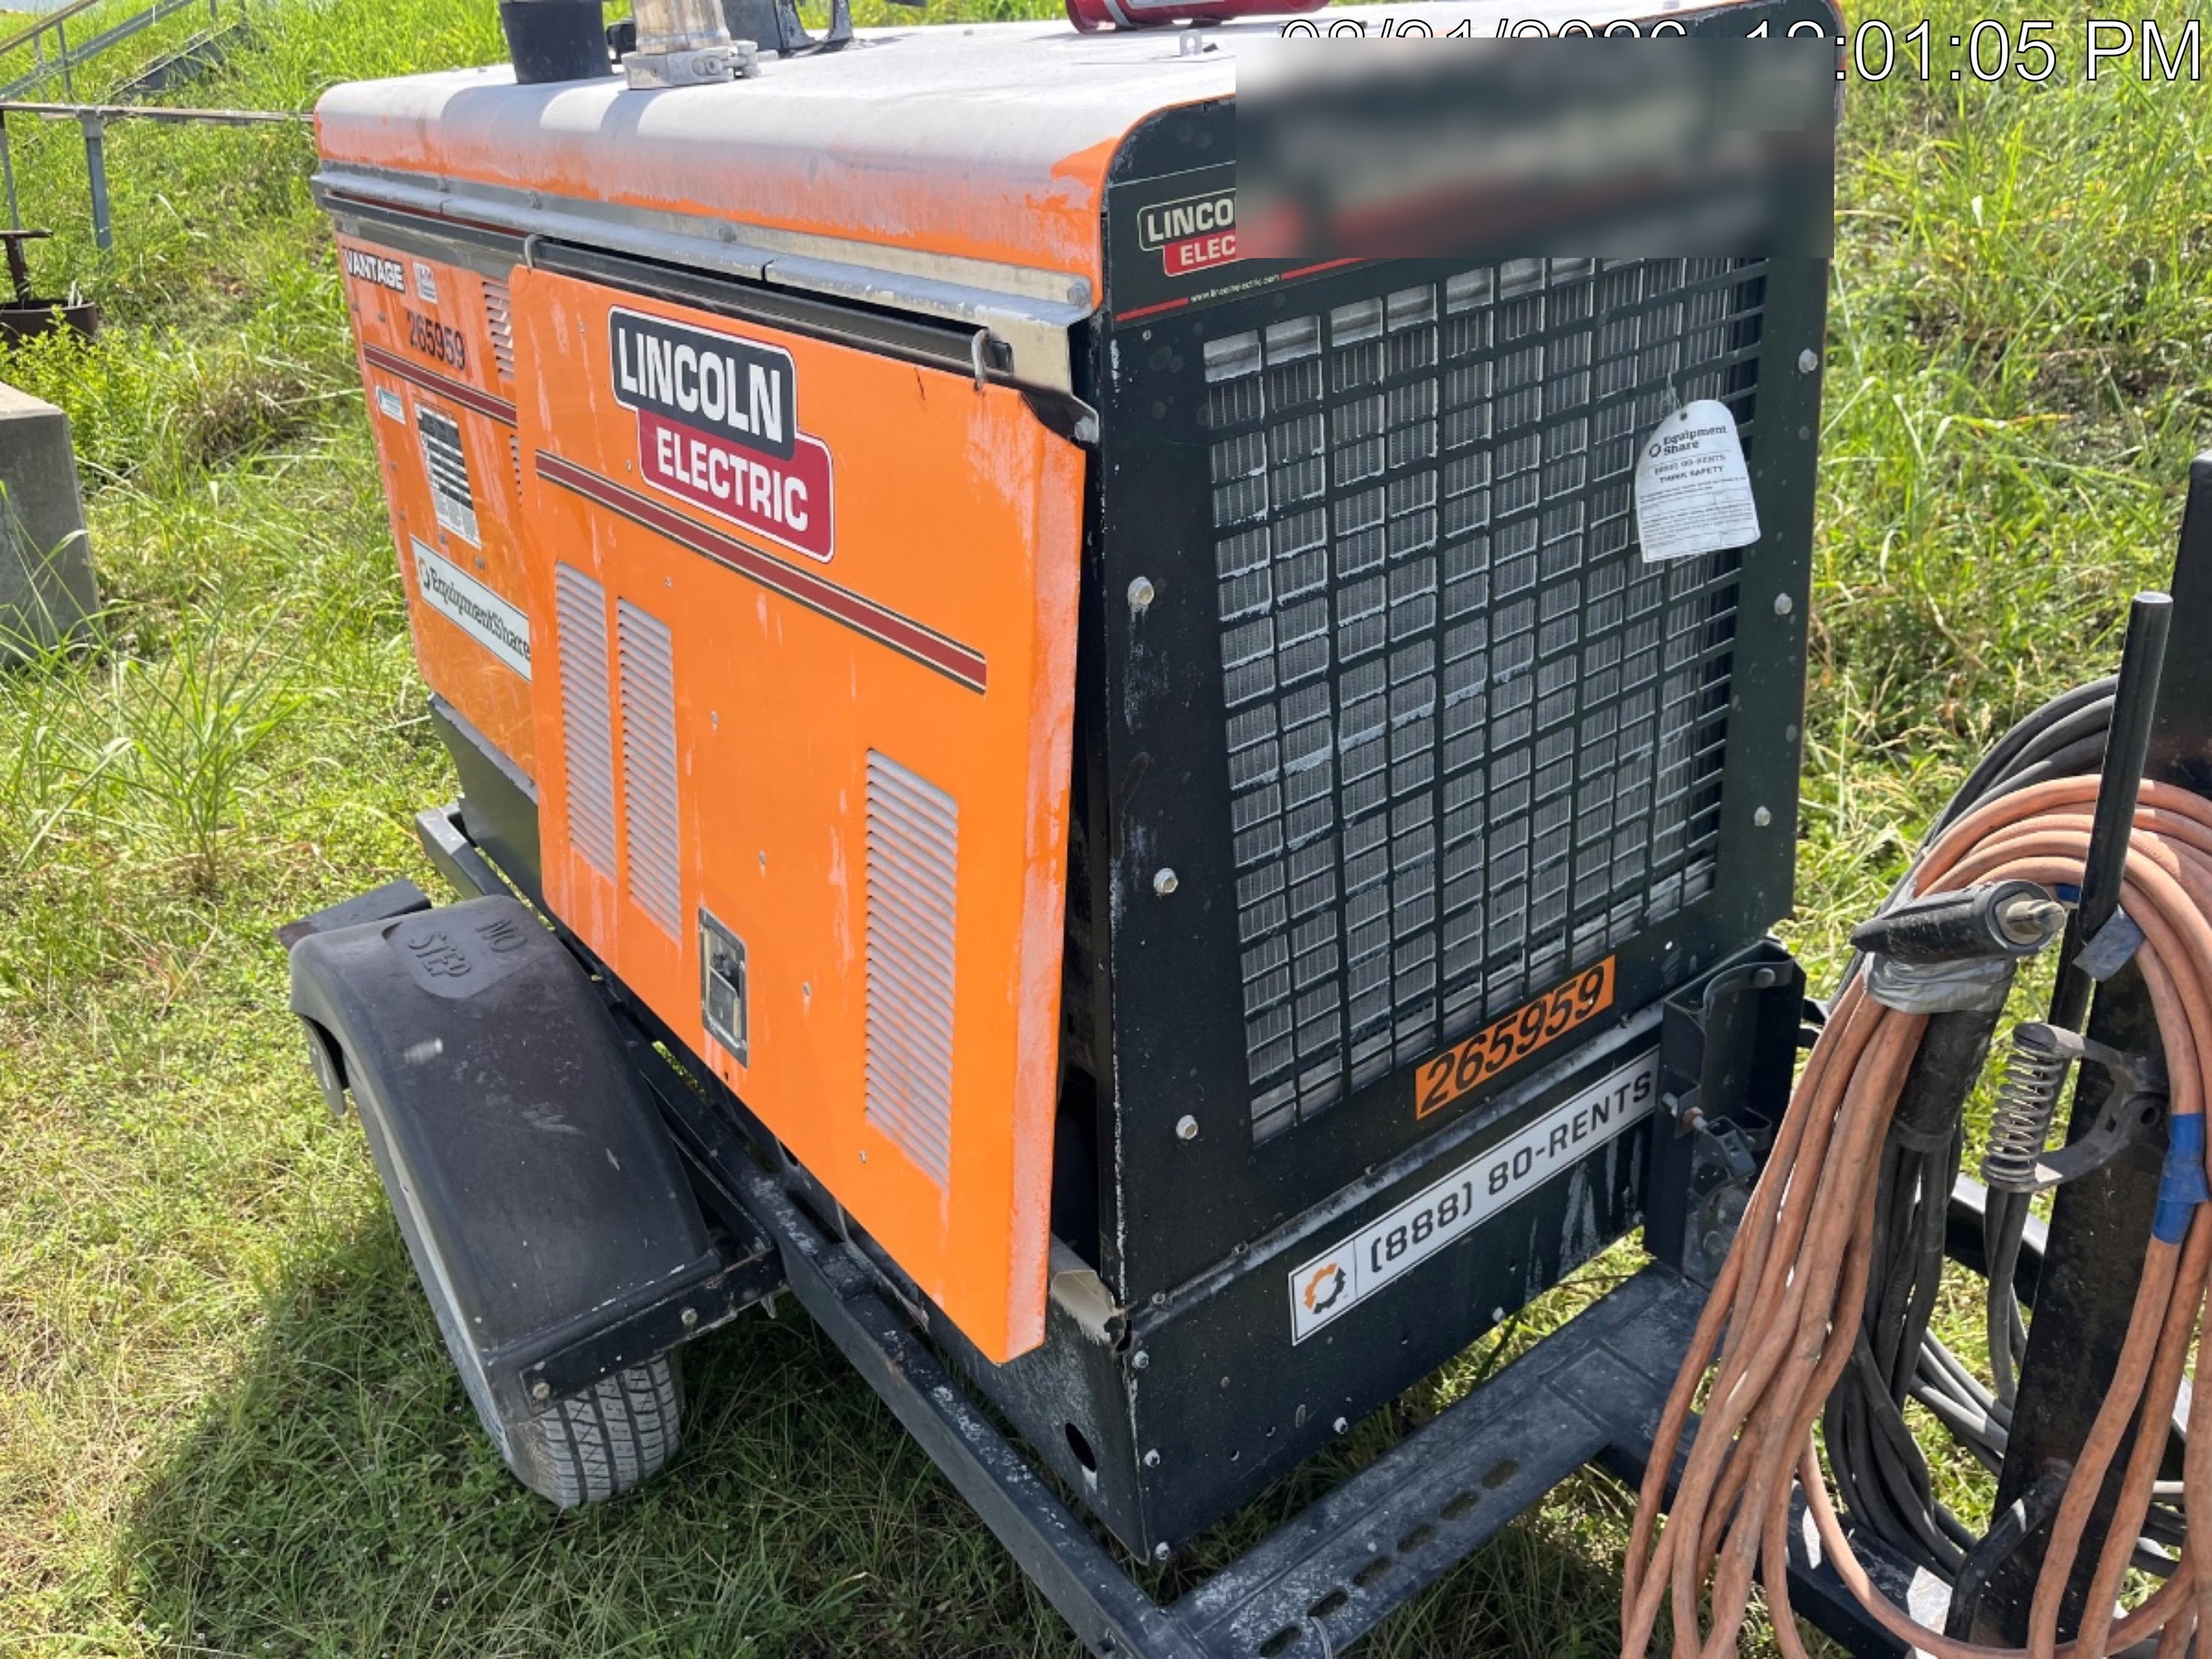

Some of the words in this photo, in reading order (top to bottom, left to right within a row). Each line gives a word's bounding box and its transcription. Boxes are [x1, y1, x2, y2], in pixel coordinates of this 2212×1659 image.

[1147, 198, 1236, 243] LINCO
[1180, 235, 1236, 266] ELEC
[345, 249, 405, 292] VANTAGE
[407, 310, 465, 370] 265959
[618, 327, 783, 443] LINCOLN
[1663, 426, 1727, 445] Equipment
[1664, 441, 1700, 455] Share
[656, 426, 808, 532] ELECTRIC
[429, 565, 531, 662] EquipmentShare
[1420, 966, 1604, 1114] 265959
[1370, 1182, 1473, 1273] (888)
[1488, 1071, 1651, 1196] 80-RENTS
